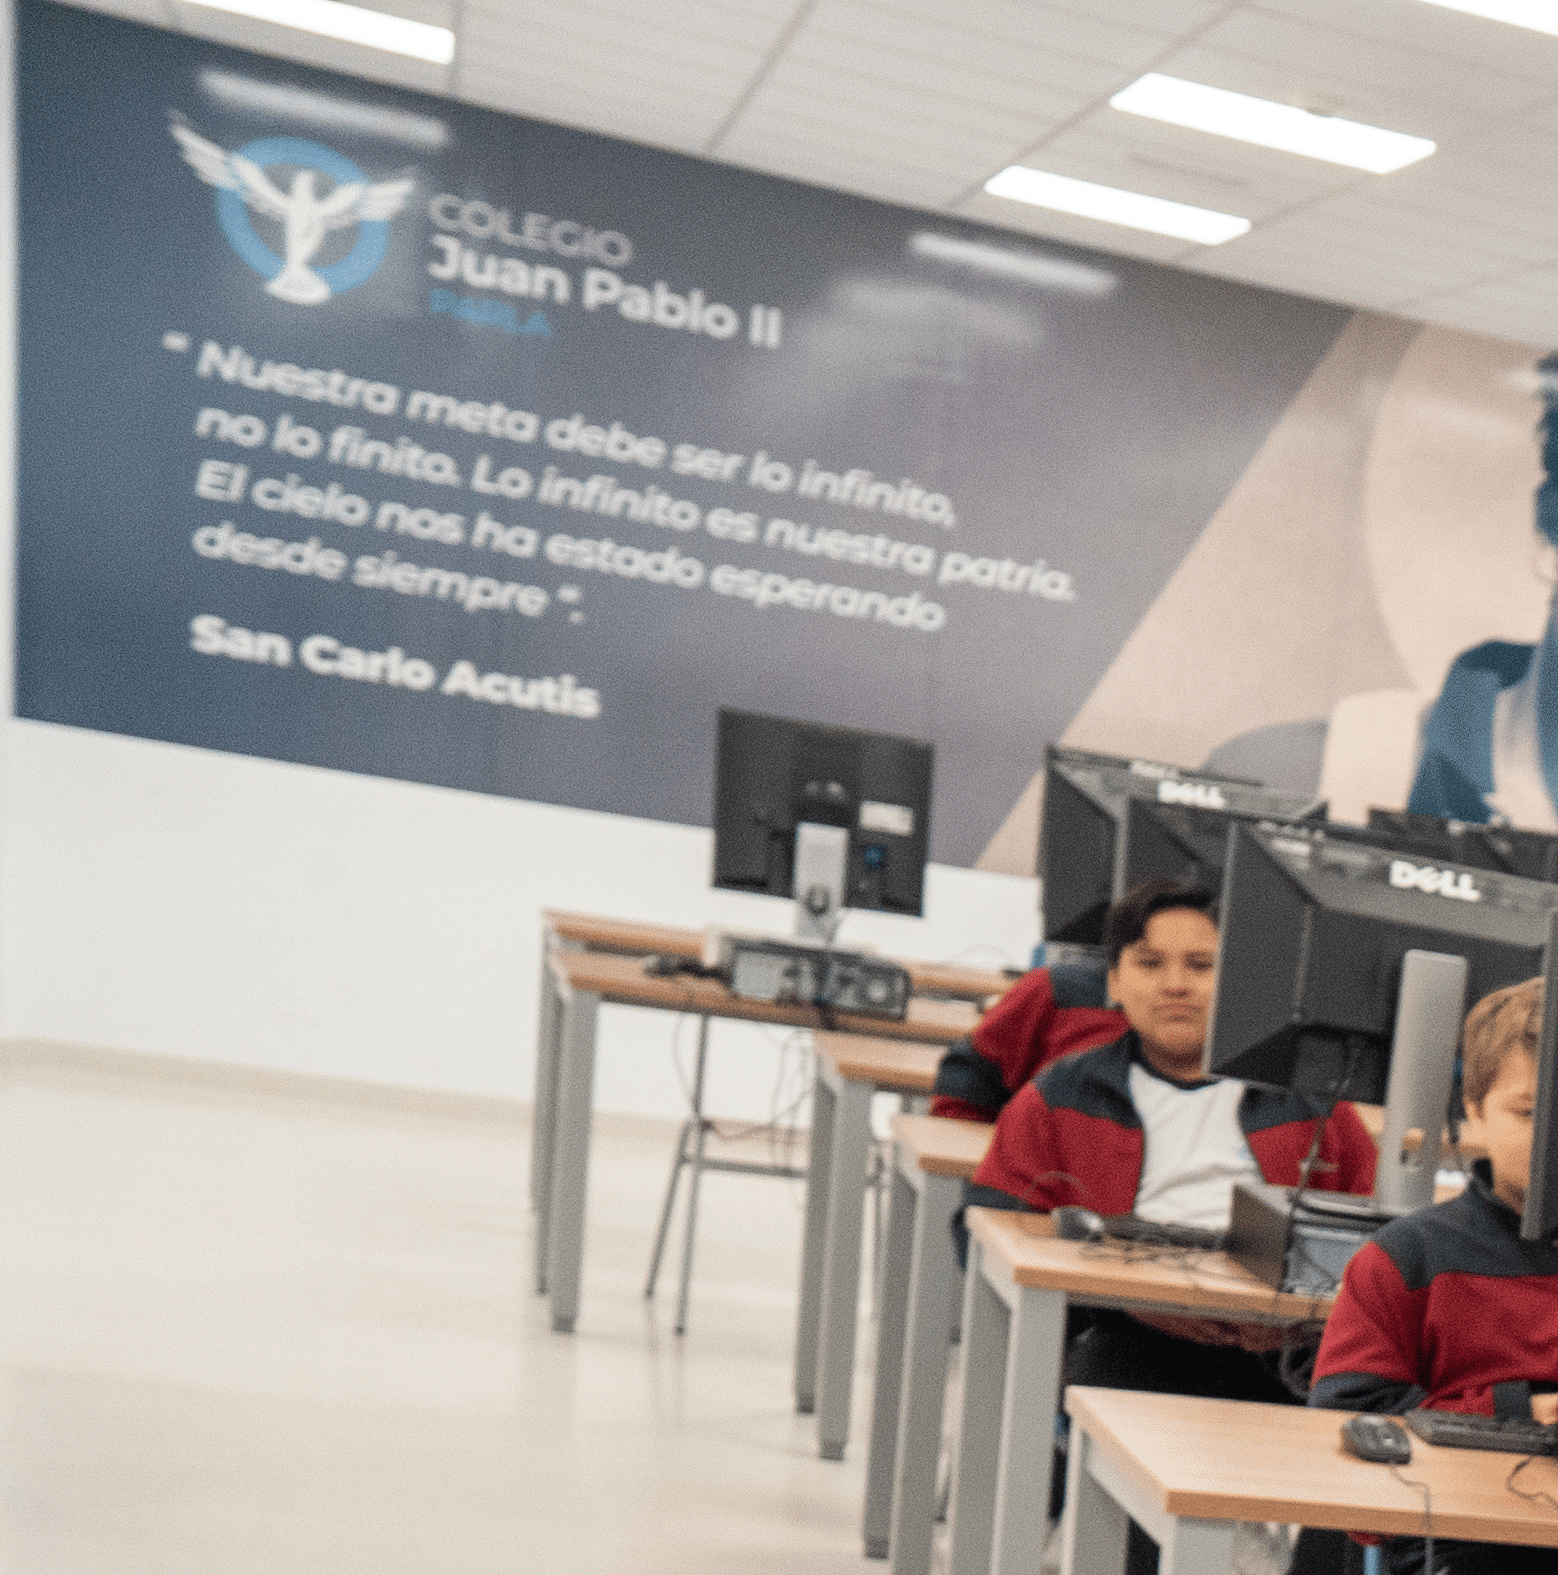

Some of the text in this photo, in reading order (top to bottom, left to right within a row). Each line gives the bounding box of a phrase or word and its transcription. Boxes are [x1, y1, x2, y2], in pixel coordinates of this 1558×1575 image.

[428, 193, 633, 267] COLEGIO
[428, 234, 782, 348] Juan Pablo II
[198, 340, 400, 415] Nuestra
[405, 390, 541, 442] meta
[544, 413, 666, 468] debe
[670, 443, 745, 481] ser
[749, 450, 793, 493] lo
[798, 459, 956, 529] infinito,
[195, 407, 1077, 600] no lo finito. Lo infinito es nuestra patria.
[195, 459, 946, 631] El cielo nos ha estado esperando
[192, 521, 347, 580] desde
[352, 550, 548, 617] siempre
[190, 615, 600, 718] San Carlo Acutis
[1389, 859, 1482, 902] DELL
